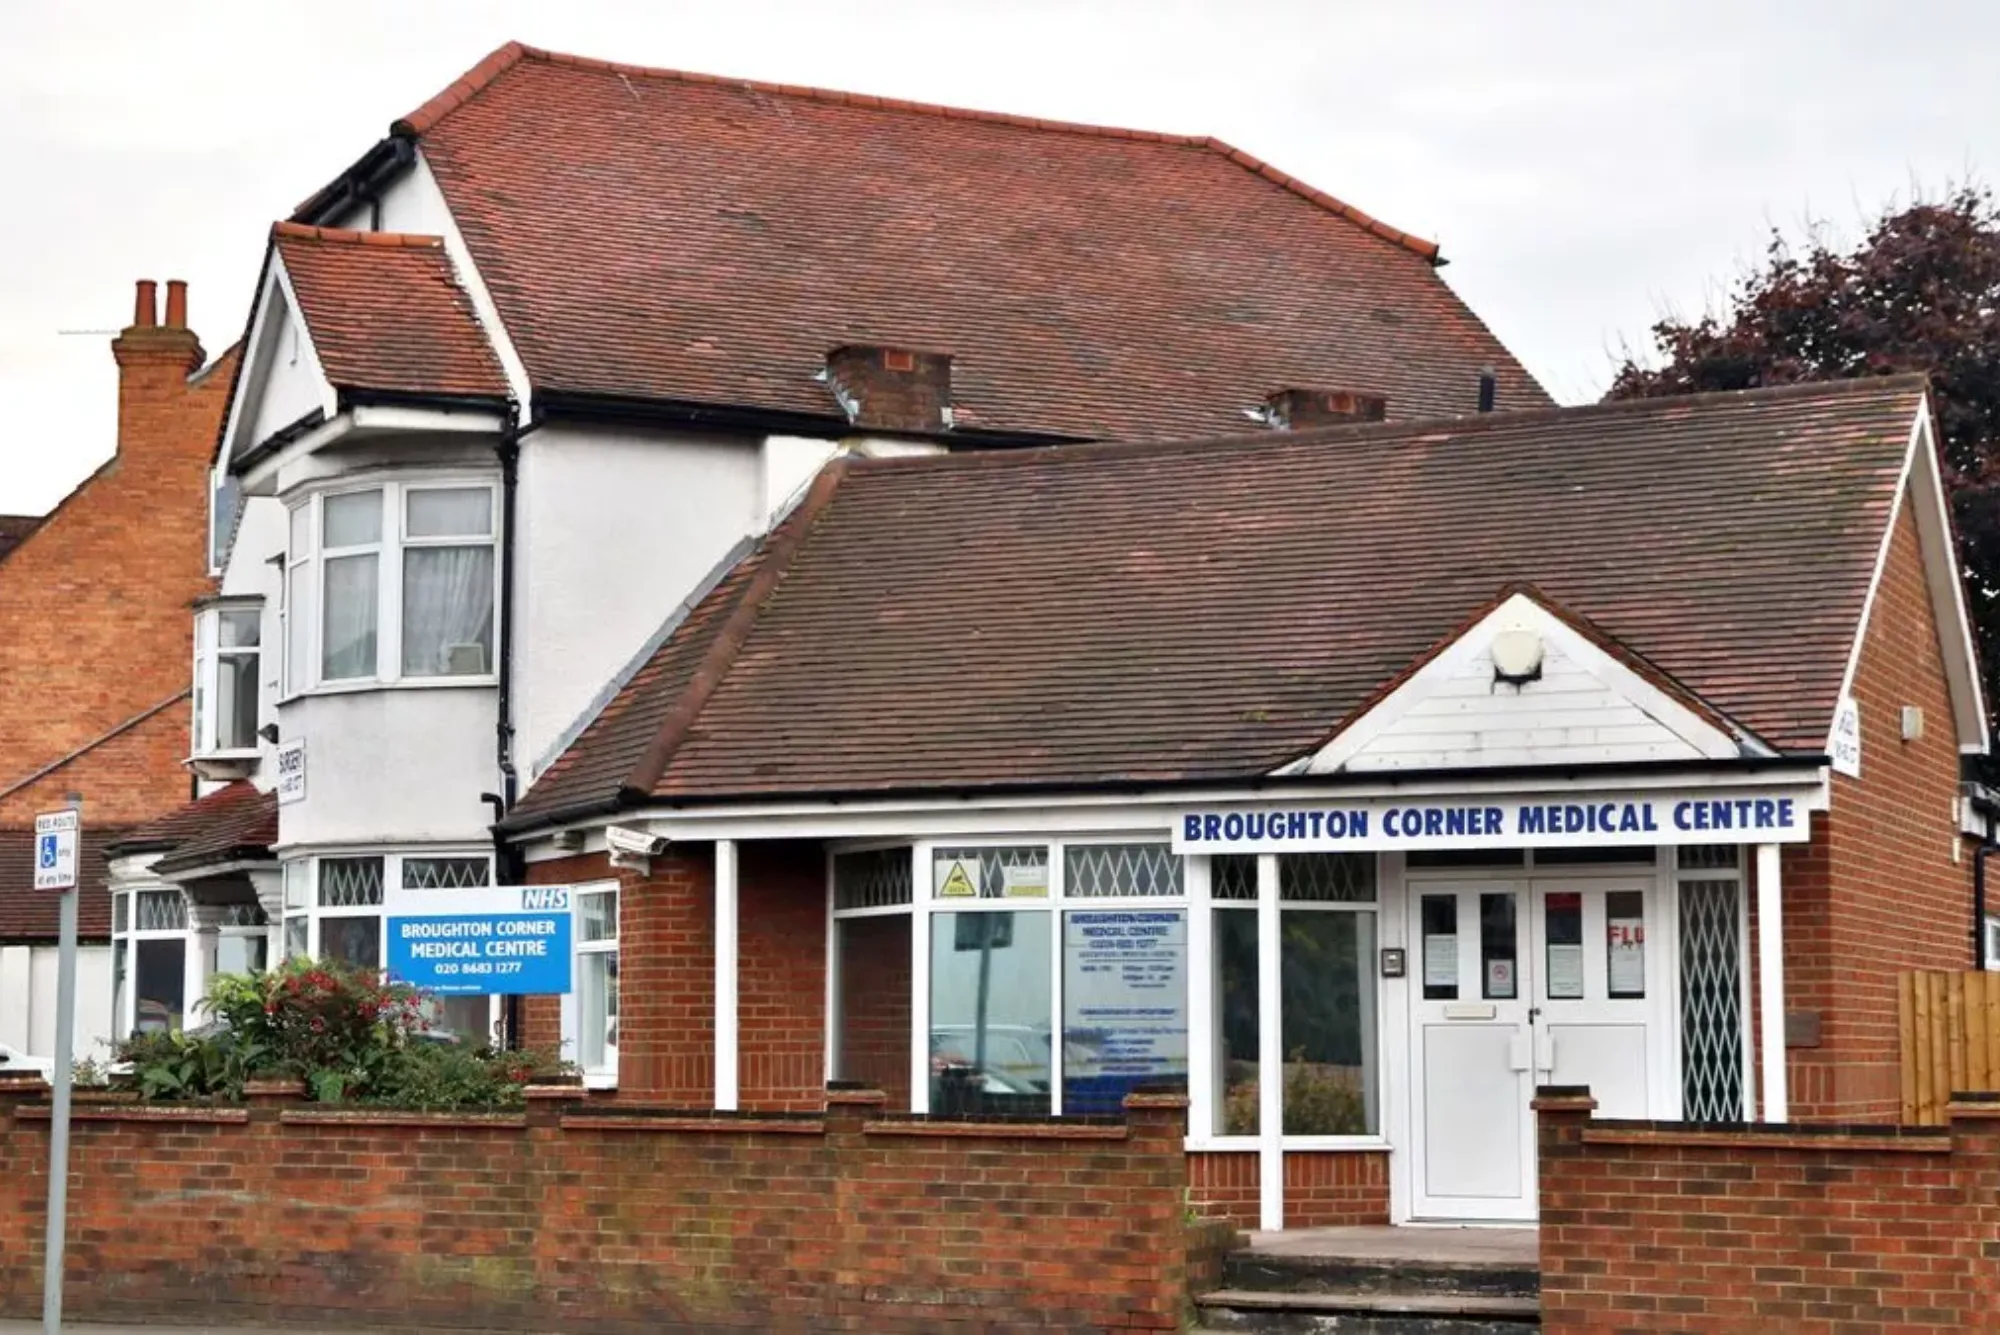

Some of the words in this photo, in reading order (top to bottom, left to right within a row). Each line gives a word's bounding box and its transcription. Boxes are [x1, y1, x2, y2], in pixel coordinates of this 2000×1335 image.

[1183, 810, 1369, 841] BROUGHTON
[1382, 806, 1504, 838] CORNER
[1517, 803, 1659, 834] MEDICAL
[1673, 798, 1795, 830] CENTRE
[523, 889, 568, 909] NHS
[401, 921, 492, 938] BROUGHTON
[496, 920, 556, 936] CORNER
[1606, 926, 1645, 946] FLU
[411, 942, 481, 959] MEDICAL
[485, 940, 547, 957] CENTRE
[435, 963, 459, 975] 020
[462, 963, 492, 975] 8683
[495, 962, 522, 973] 1277
